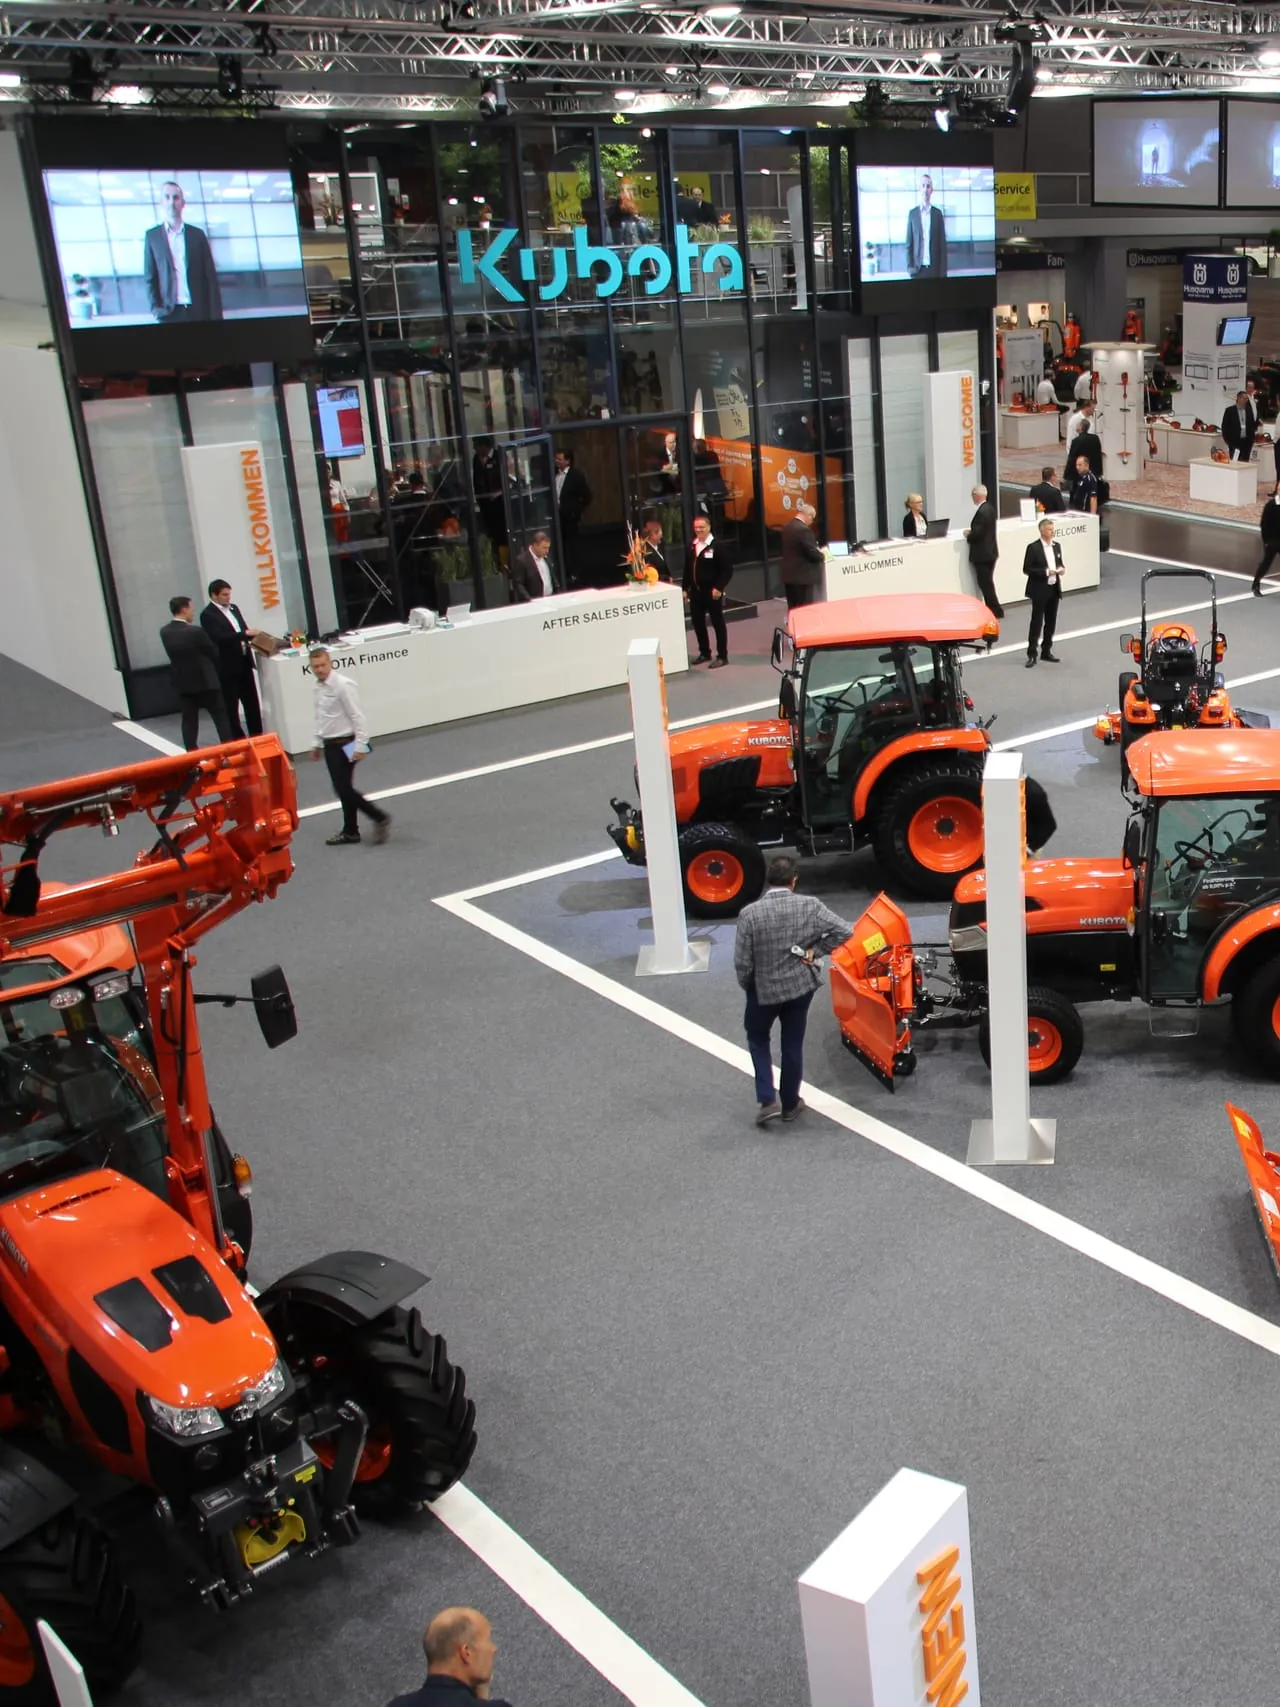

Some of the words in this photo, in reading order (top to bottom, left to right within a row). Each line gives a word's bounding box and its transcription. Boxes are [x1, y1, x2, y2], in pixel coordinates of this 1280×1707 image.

[457, 224, 744, 302] Kubota
[961, 375, 976, 468] WELCOME
[240, 448, 281, 610] WILLKOMMEN
[1053, 524, 1088, 538] ELCOME
[841, 556, 904, 576] WILLKOMMEN
[542, 615, 581, 632] AFTER
[582, 607, 620, 624] SALES
[622, 598, 669, 616] SERVICE
[301, 656, 356, 676] KOTA
[359, 647, 409, 664] Finance
[747, 736, 789, 747] KUBOTA
[1079, 916, 1127, 926] KUBOTA
[916, 1545, 969, 1707] NEW
